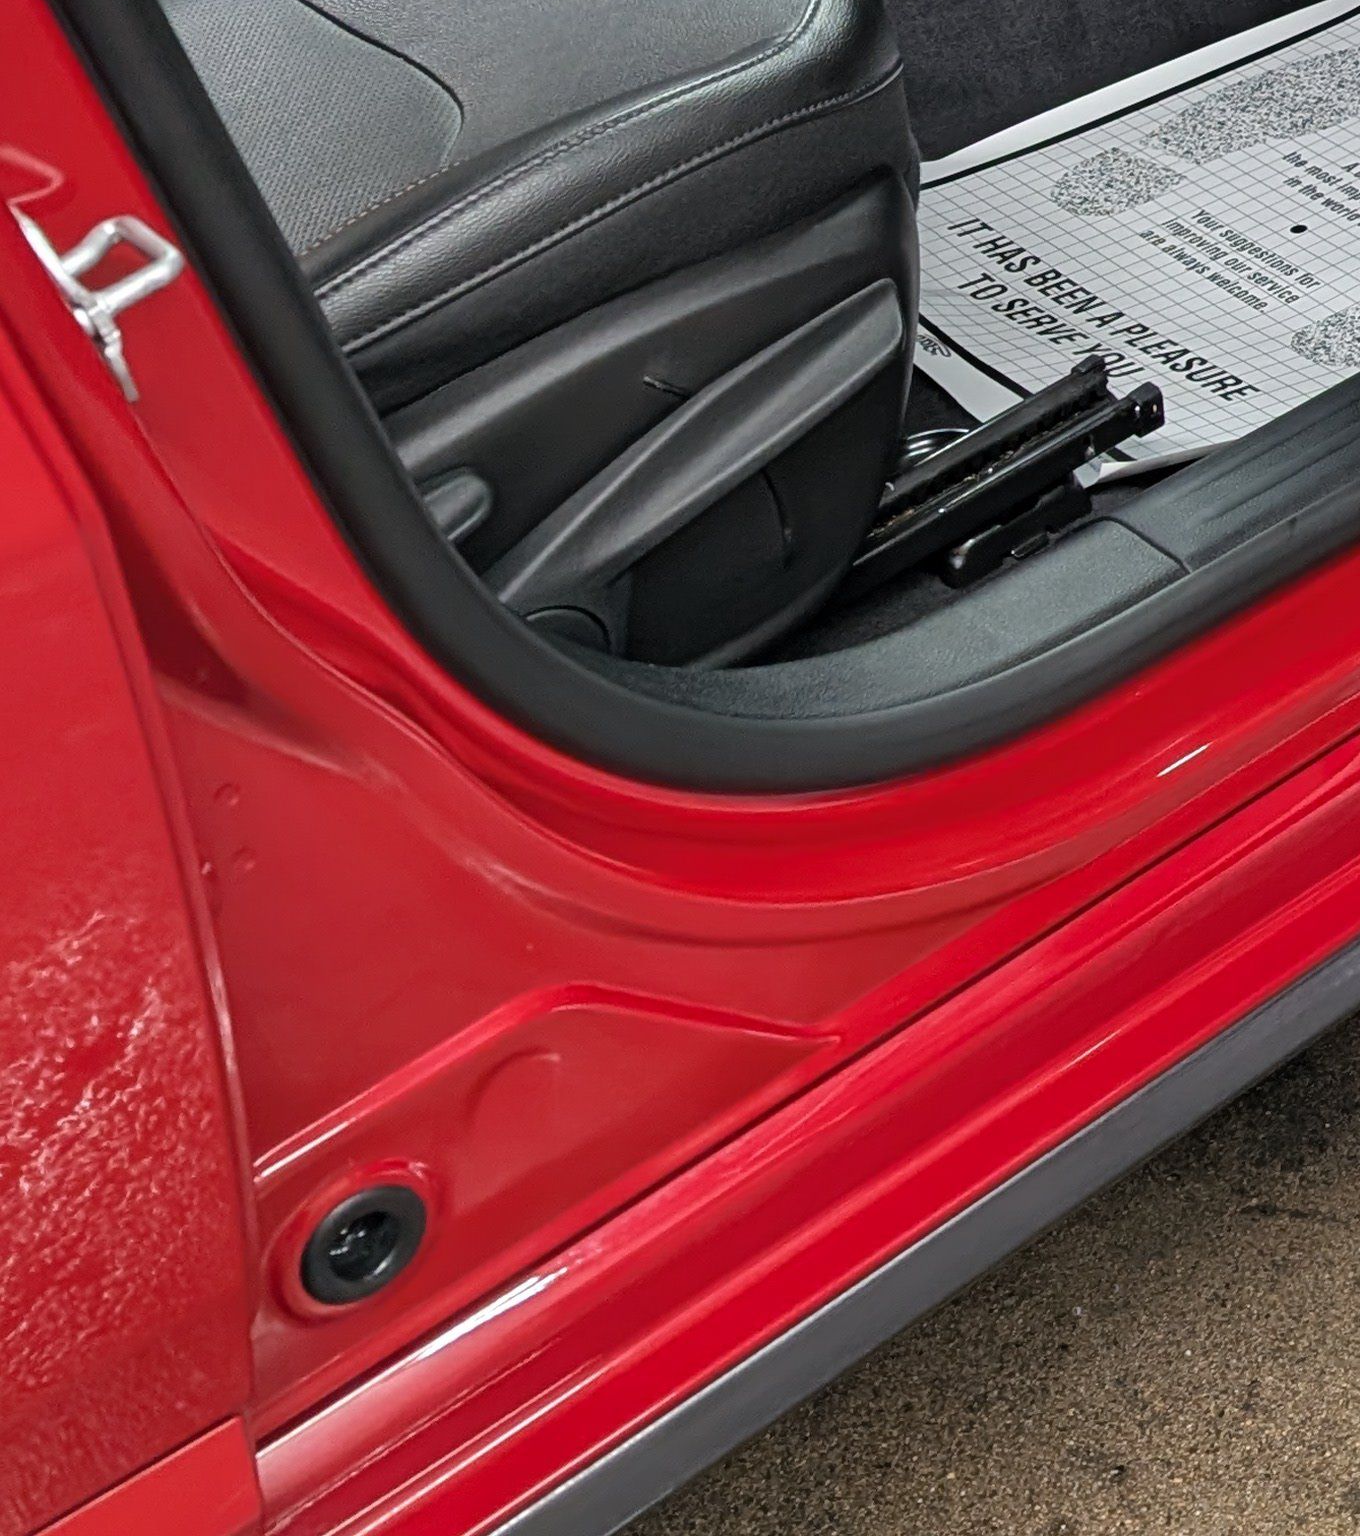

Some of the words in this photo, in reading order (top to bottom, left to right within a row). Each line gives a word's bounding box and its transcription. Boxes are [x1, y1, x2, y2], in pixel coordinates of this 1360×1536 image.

[1282, 151, 1308, 168] the
[1304, 166, 1343, 186] most
[1283, 176, 1302, 188] in
[1298, 183, 1325, 201] the
[1341, 162, 1360, 173] A
[1139, 229, 1166, 247] are
[1161, 244, 1211, 275] always
[1206, 272, 1269, 313] welcome.
[1161, 217, 1229, 261] improving
[1224, 257, 1253, 275] our
[1247, 271, 1301, 305] service
[1190, 209, 1224, 231] Your
[1219, 229, 1299, 277] suggestions
[1294, 271, 1321, 289] for
[947, 218, 994, 237] IT
[972, 235, 1042, 273] HAS
[1023, 268, 1107, 315] BEEN
[1085, 311, 1126, 328] A
[1108, 323, 1261, 401] PLEASURE
[957, 272, 1008, 301] TO
[991, 298, 1090, 345] SERVE
[1072, 342, 1146, 378] YOU
